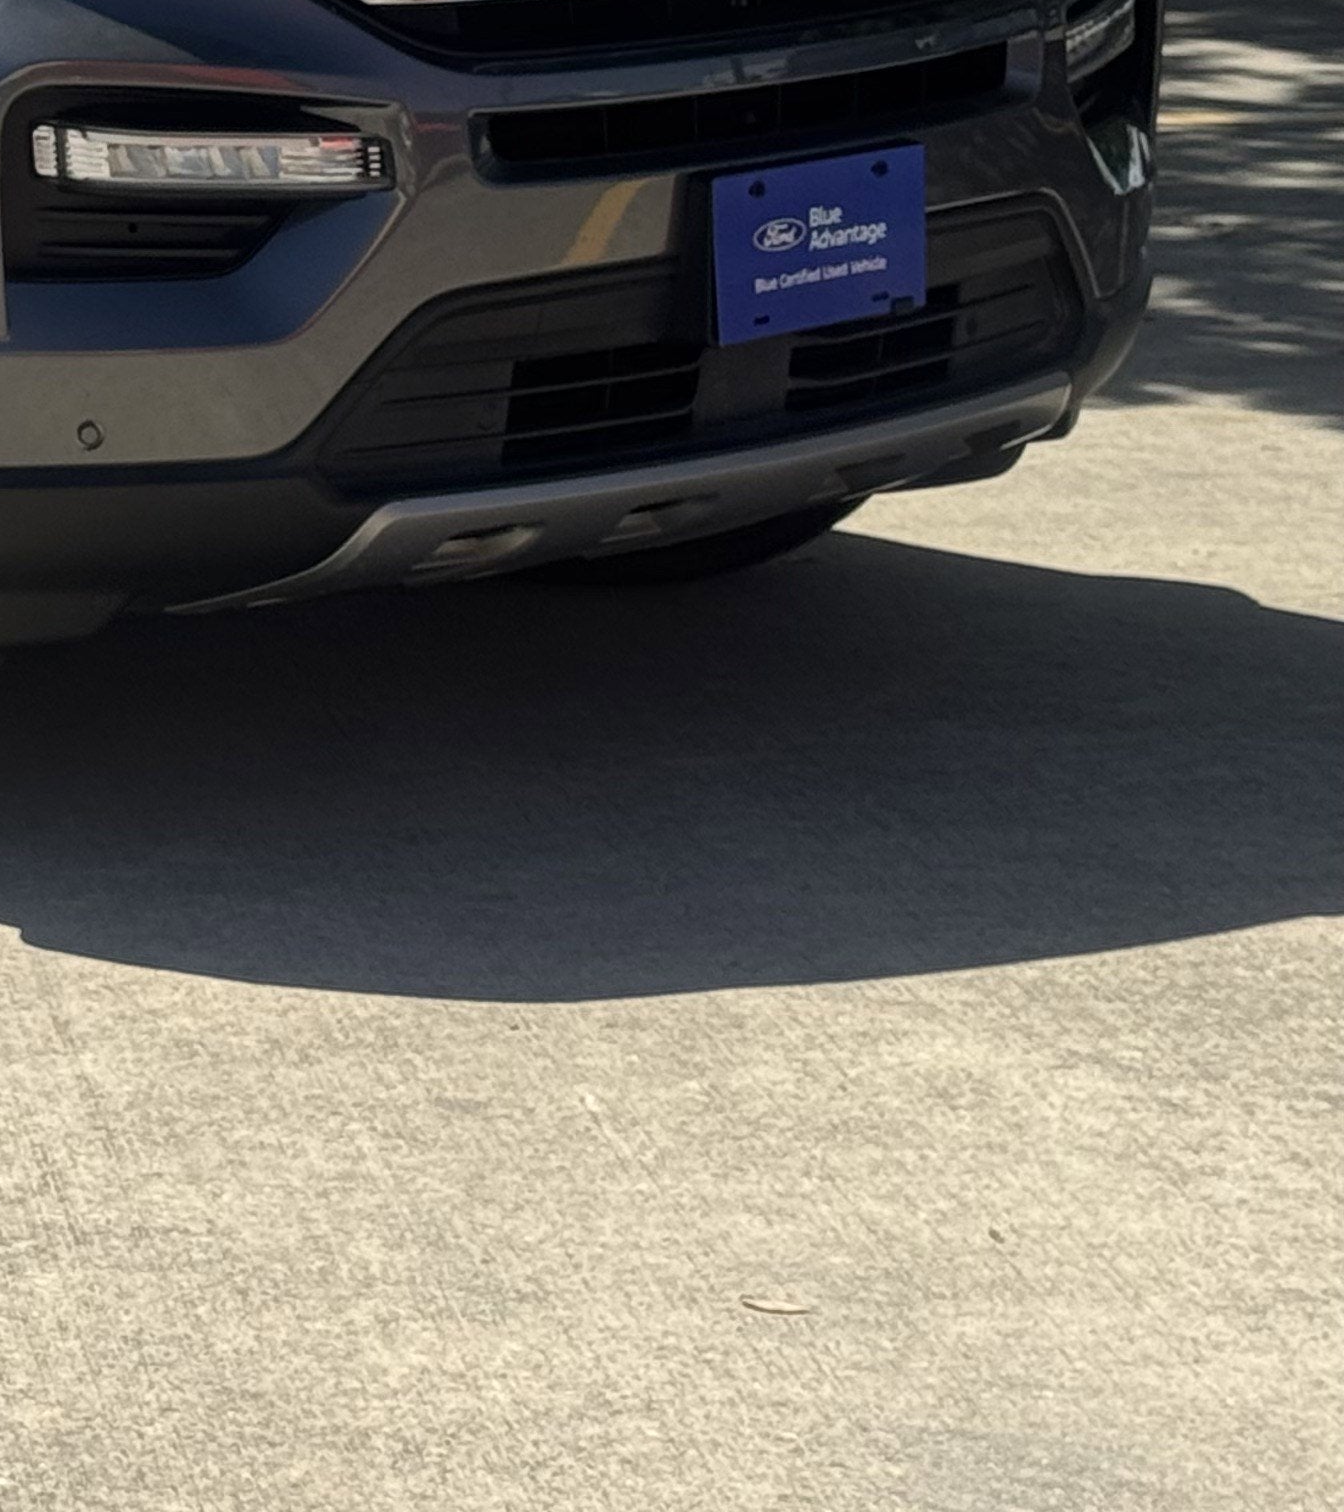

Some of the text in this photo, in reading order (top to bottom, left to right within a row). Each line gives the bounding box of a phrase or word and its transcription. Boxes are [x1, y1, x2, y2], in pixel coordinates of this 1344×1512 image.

[763, 205, 843, 248] Ford Blue
[808, 221, 888, 252] Advantage
